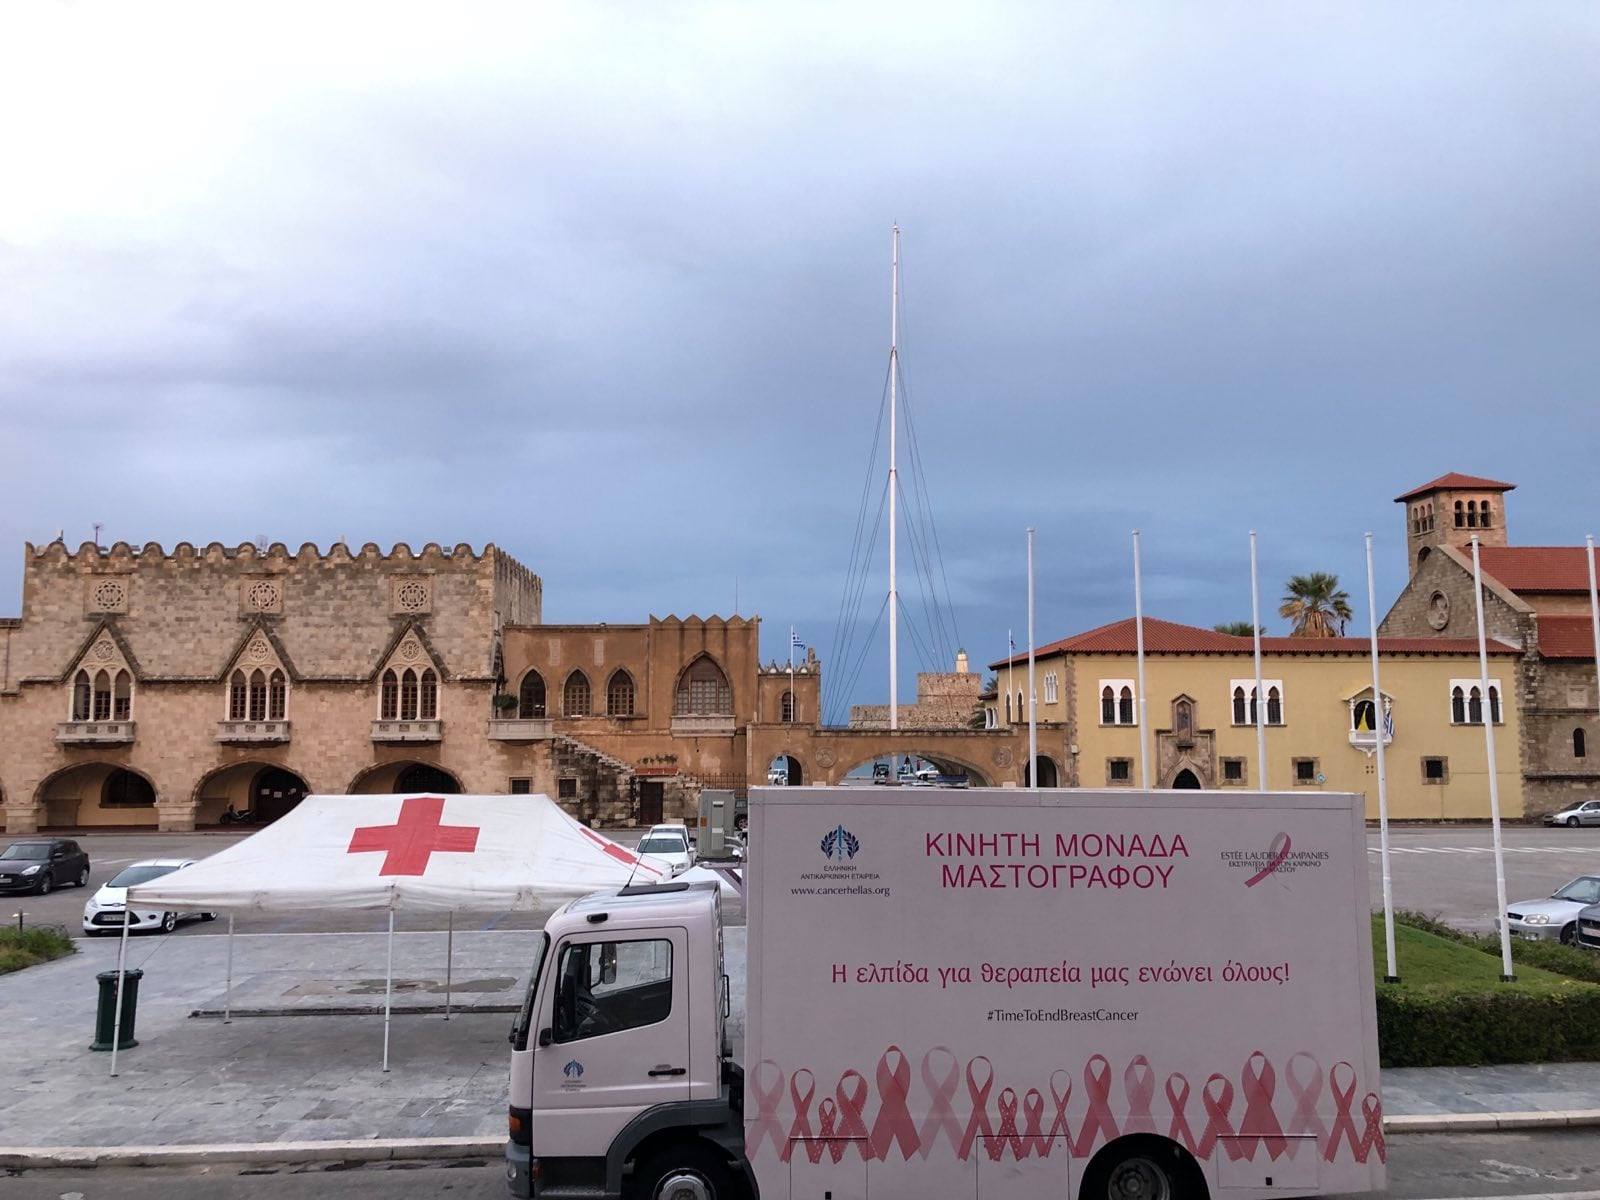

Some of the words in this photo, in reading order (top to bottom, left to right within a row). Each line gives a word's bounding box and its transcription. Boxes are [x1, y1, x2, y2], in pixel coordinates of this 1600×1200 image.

[925, 832, 1040, 857] ΚΙΝΗΤΗ
[1055, 833, 1190, 858] ΜΟΝΑΔΑ
[942, 864, 1175, 889] ΜΑΣΤΟΓΡΑΦΟΥ
[790, 885, 891, 898] www.cancerhellas.org
[856, 960, 930, 983] ελπίδα
[937, 966, 972, 989] για
[980, 960, 1082, 989] θεραπεία
[1091, 966, 1130, 989] μας
[1138, 960, 1213, 983] ενώνει
[1222, 960, 1290, 986] όλους!
[987, 1008, 1139, 1022] #TimeToEndBreastCancer
